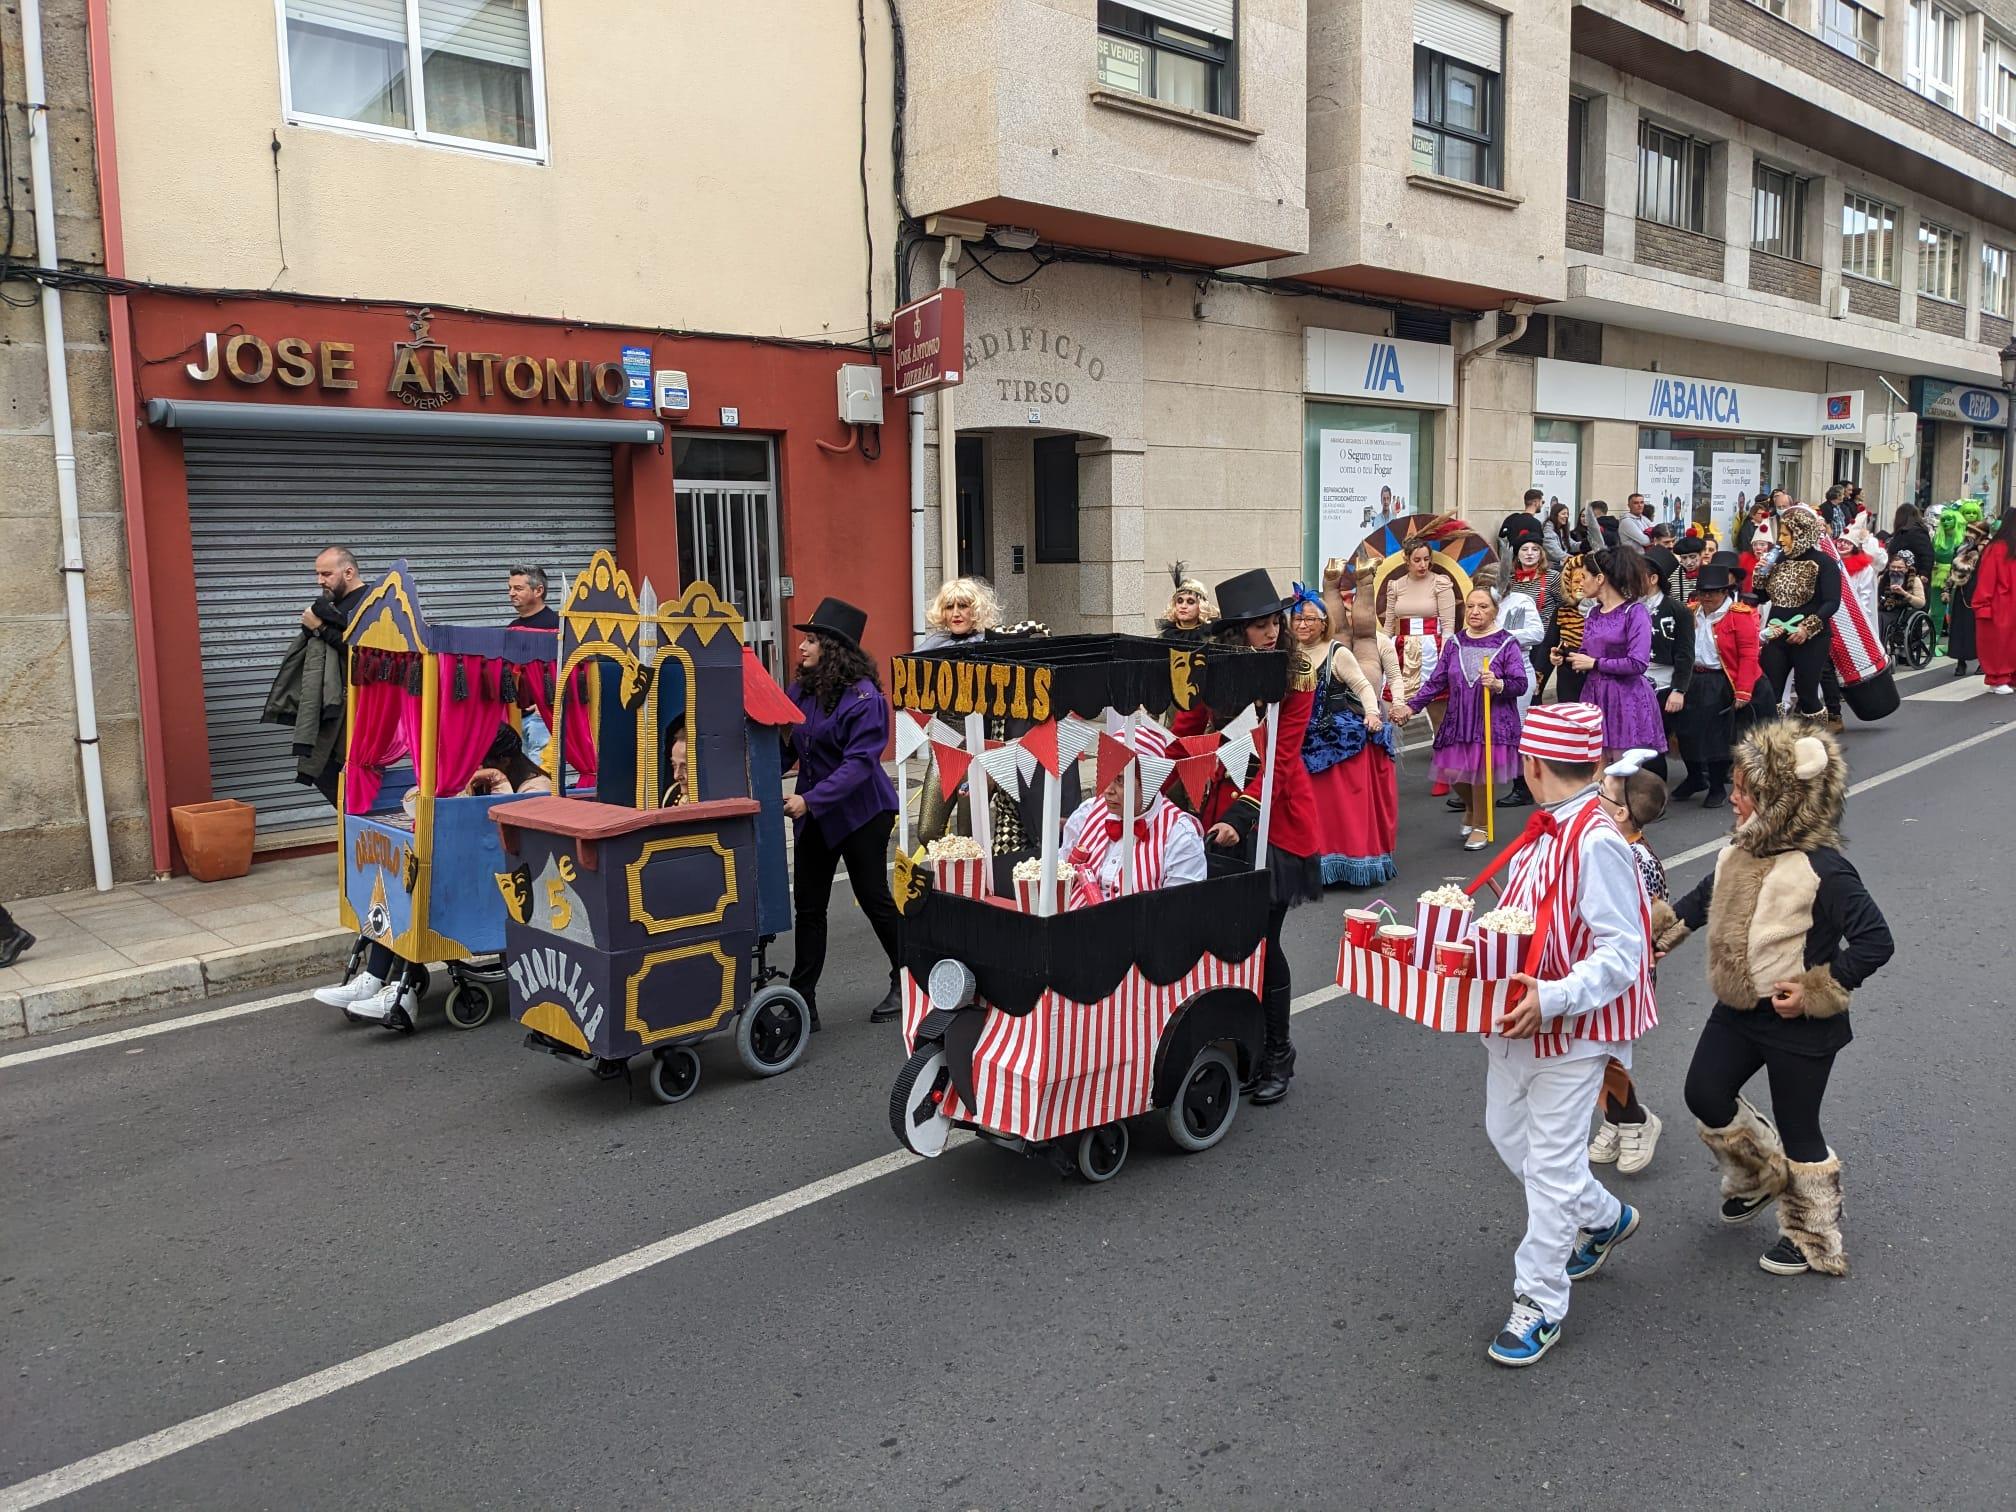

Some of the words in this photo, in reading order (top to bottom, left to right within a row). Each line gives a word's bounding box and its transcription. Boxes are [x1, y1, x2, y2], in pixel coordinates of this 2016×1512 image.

[1098, 40, 1108, 55] SE
[1110, 42, 1139, 64] VENDE
[1412, 137, 1433, 154] VENDE
[1021, 288, 1041, 311] 75
[964, 326, 1104, 381] EDIFICIO
[186, 332, 358, 389] JOSE
[388, 348, 630, 404] ANTONIO
[396, 389, 453, 411] JOYERIAS
[997, 378, 1070, 404] TIRSO
[1968, 392, 1991, 418] PEPA
[1340, 449, 1346, 460] O
[1348, 449, 1371, 463] Seguro
[1374, 464, 1392, 478] Fogar
[892, 657, 1051, 721] PALOMITAS
[508, 948, 604, 1043] TAQUILLA
